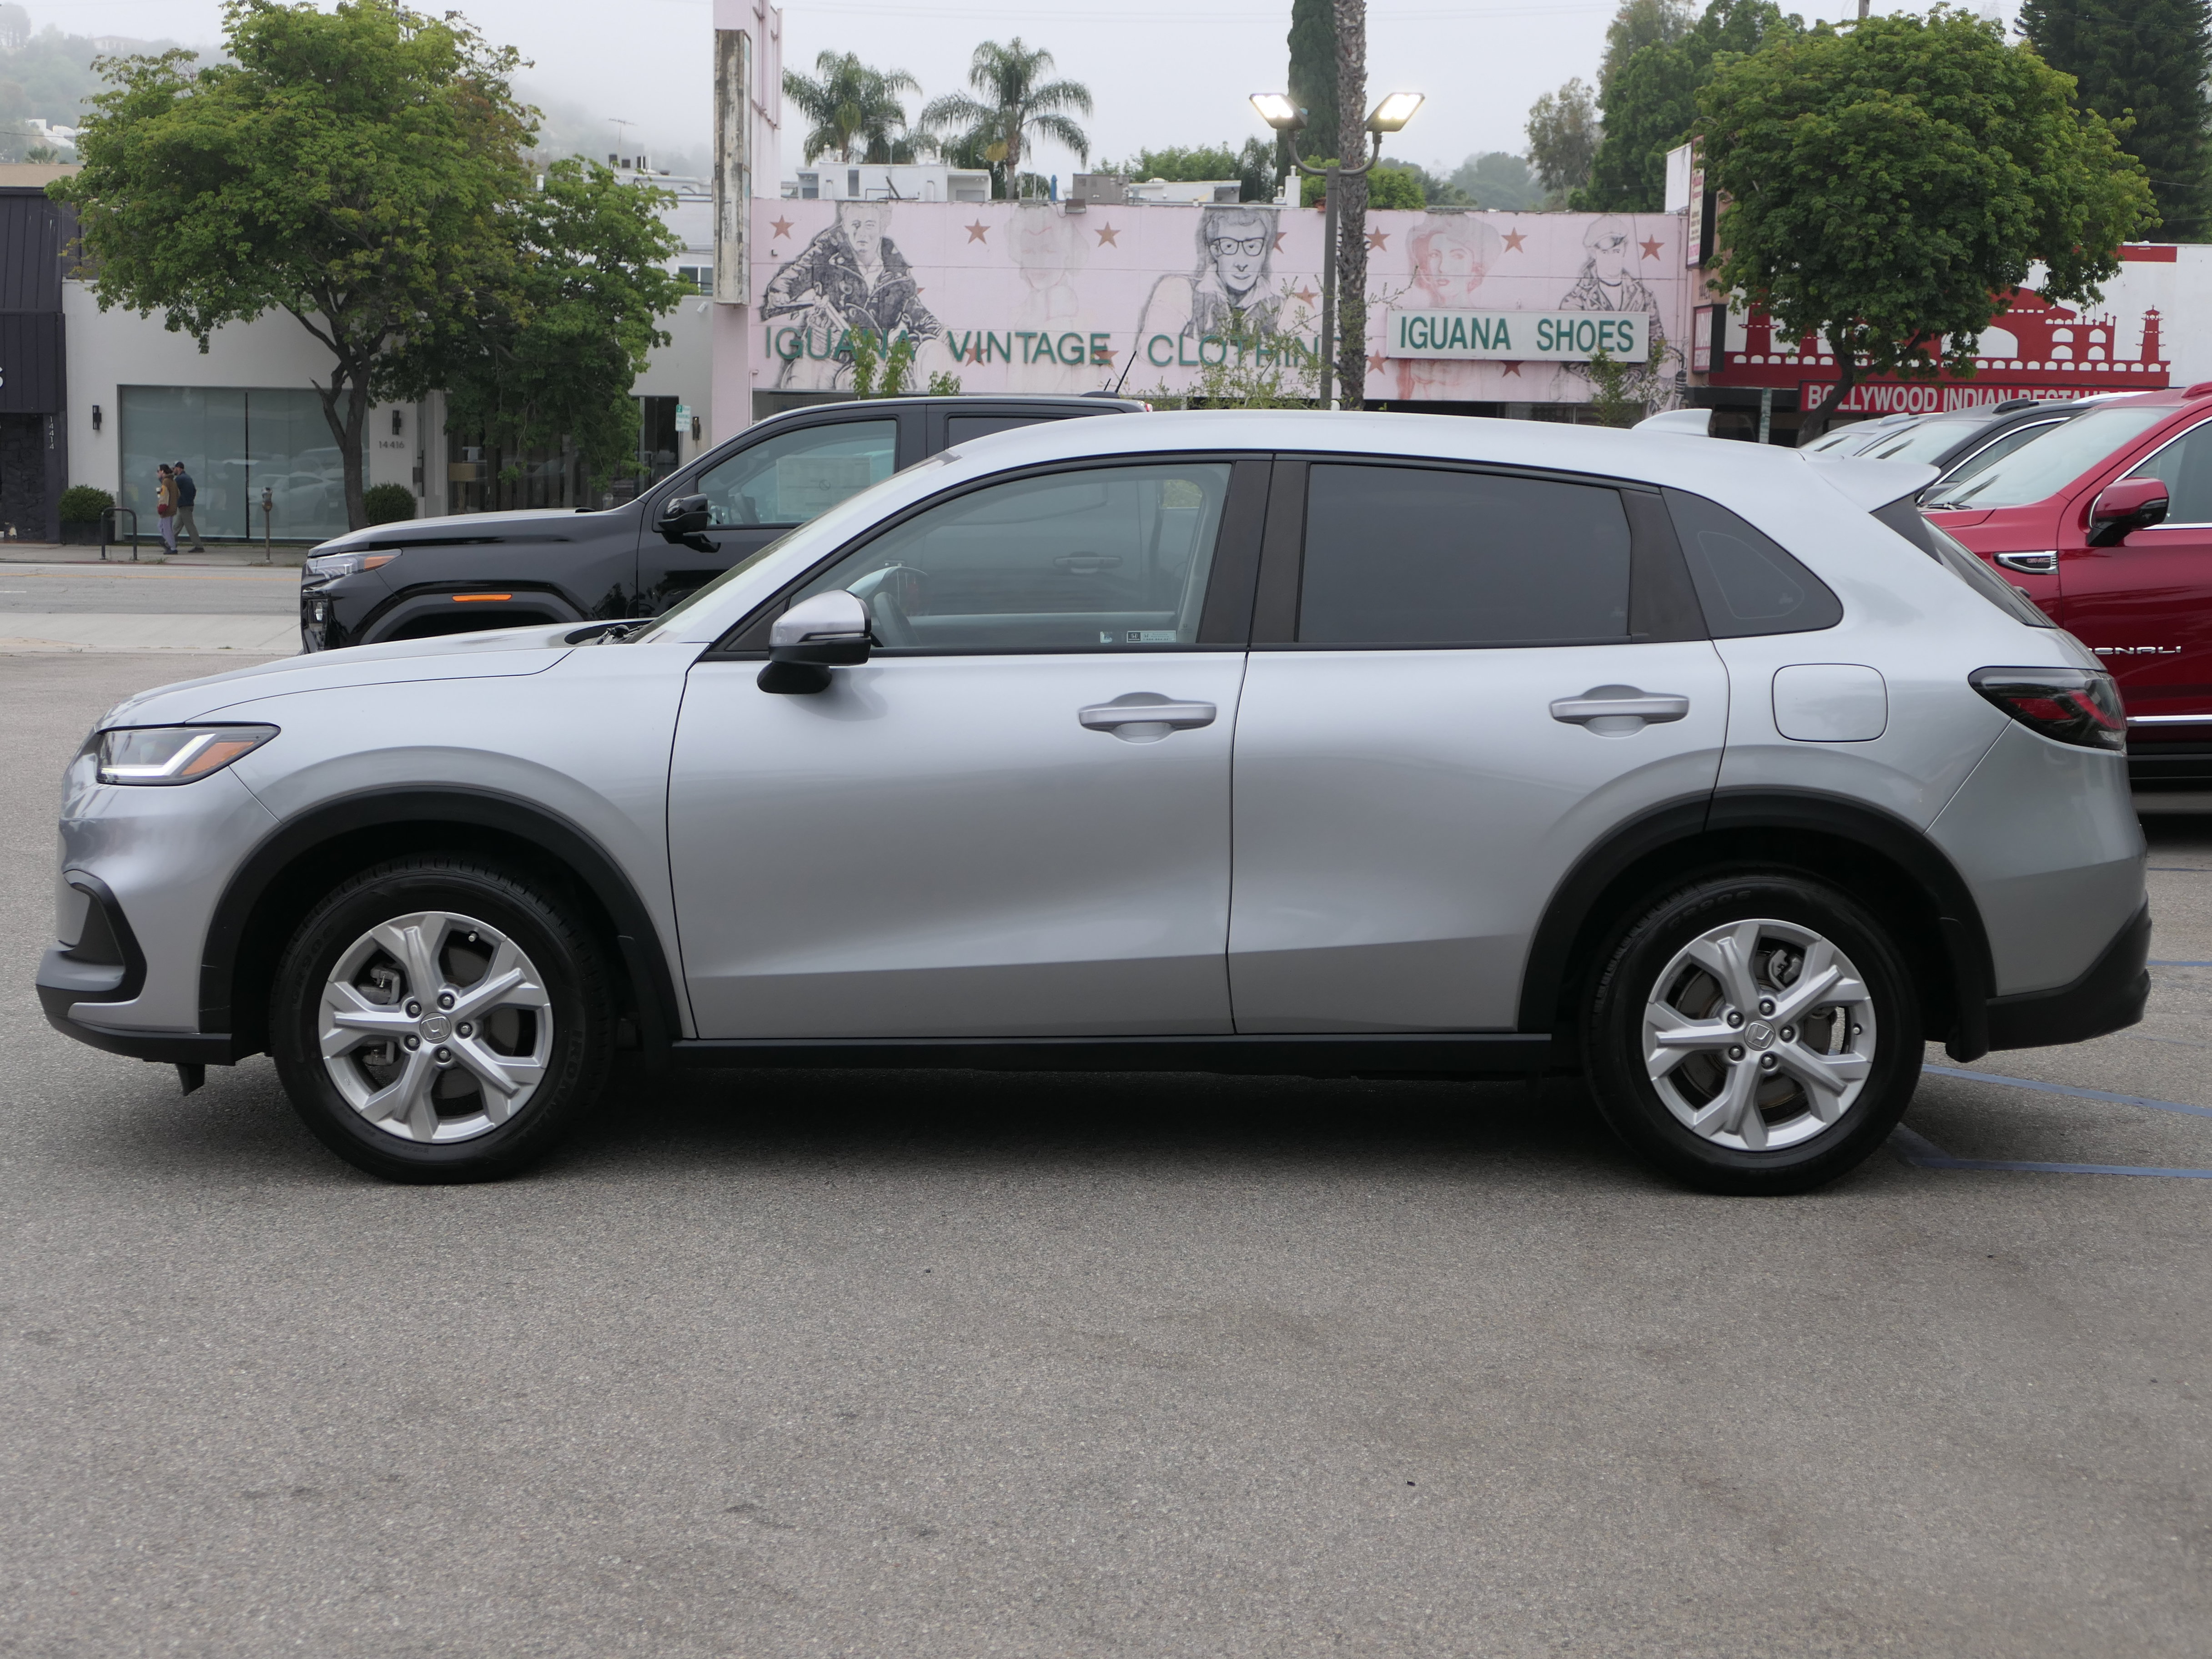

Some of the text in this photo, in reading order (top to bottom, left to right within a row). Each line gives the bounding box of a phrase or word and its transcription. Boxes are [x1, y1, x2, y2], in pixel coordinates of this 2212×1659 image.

[1400, 316, 1634, 352] IGUANA SHOES
[766, 326, 1341, 367] IGUANA VINTAGE CLOTHIN
[379, 441, 404, 449] 14416
[2088, 646, 2181, 655] ENALI
